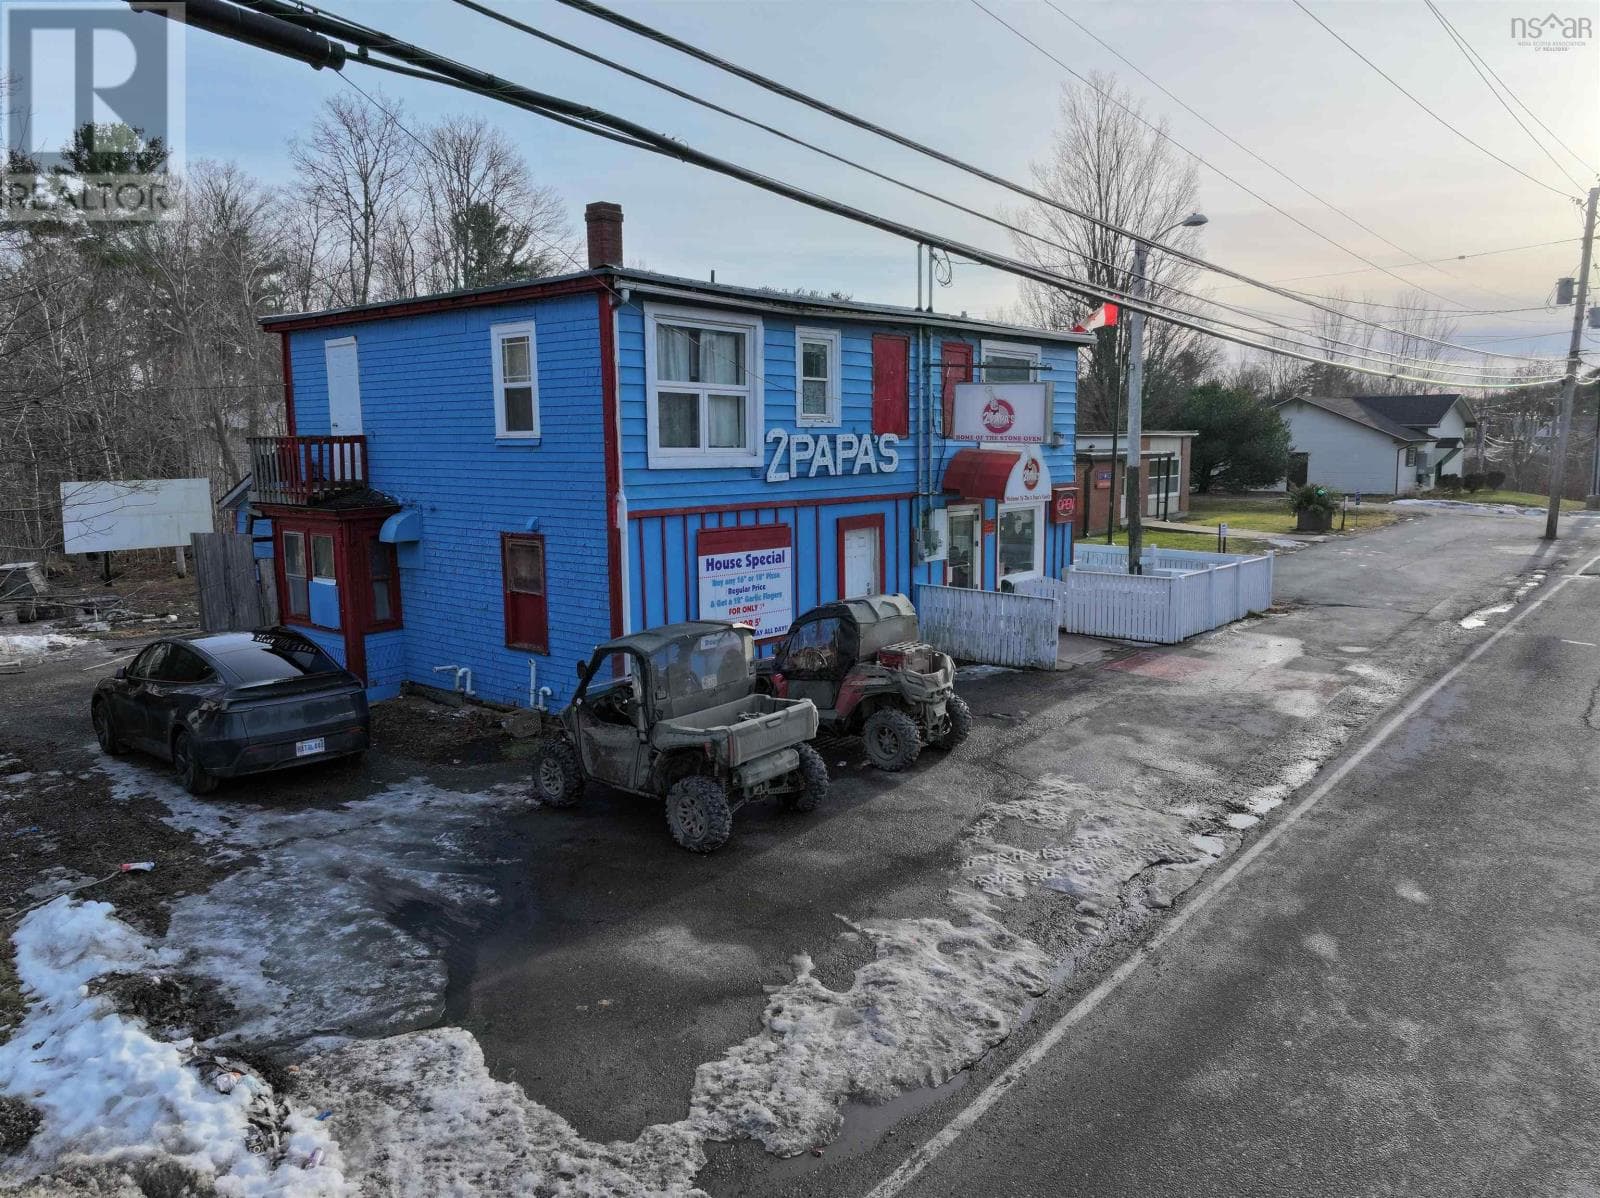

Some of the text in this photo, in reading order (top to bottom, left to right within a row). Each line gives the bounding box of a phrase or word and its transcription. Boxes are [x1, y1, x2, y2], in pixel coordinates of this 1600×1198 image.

[705, 550, 785, 572] House Special
[725, 578, 735, 586] any
[728, 586, 750, 595] Regular
[717, 600, 727, 608] Get
[742, 604, 758, 613] ONLY
[764, 627, 773, 635] ALL
